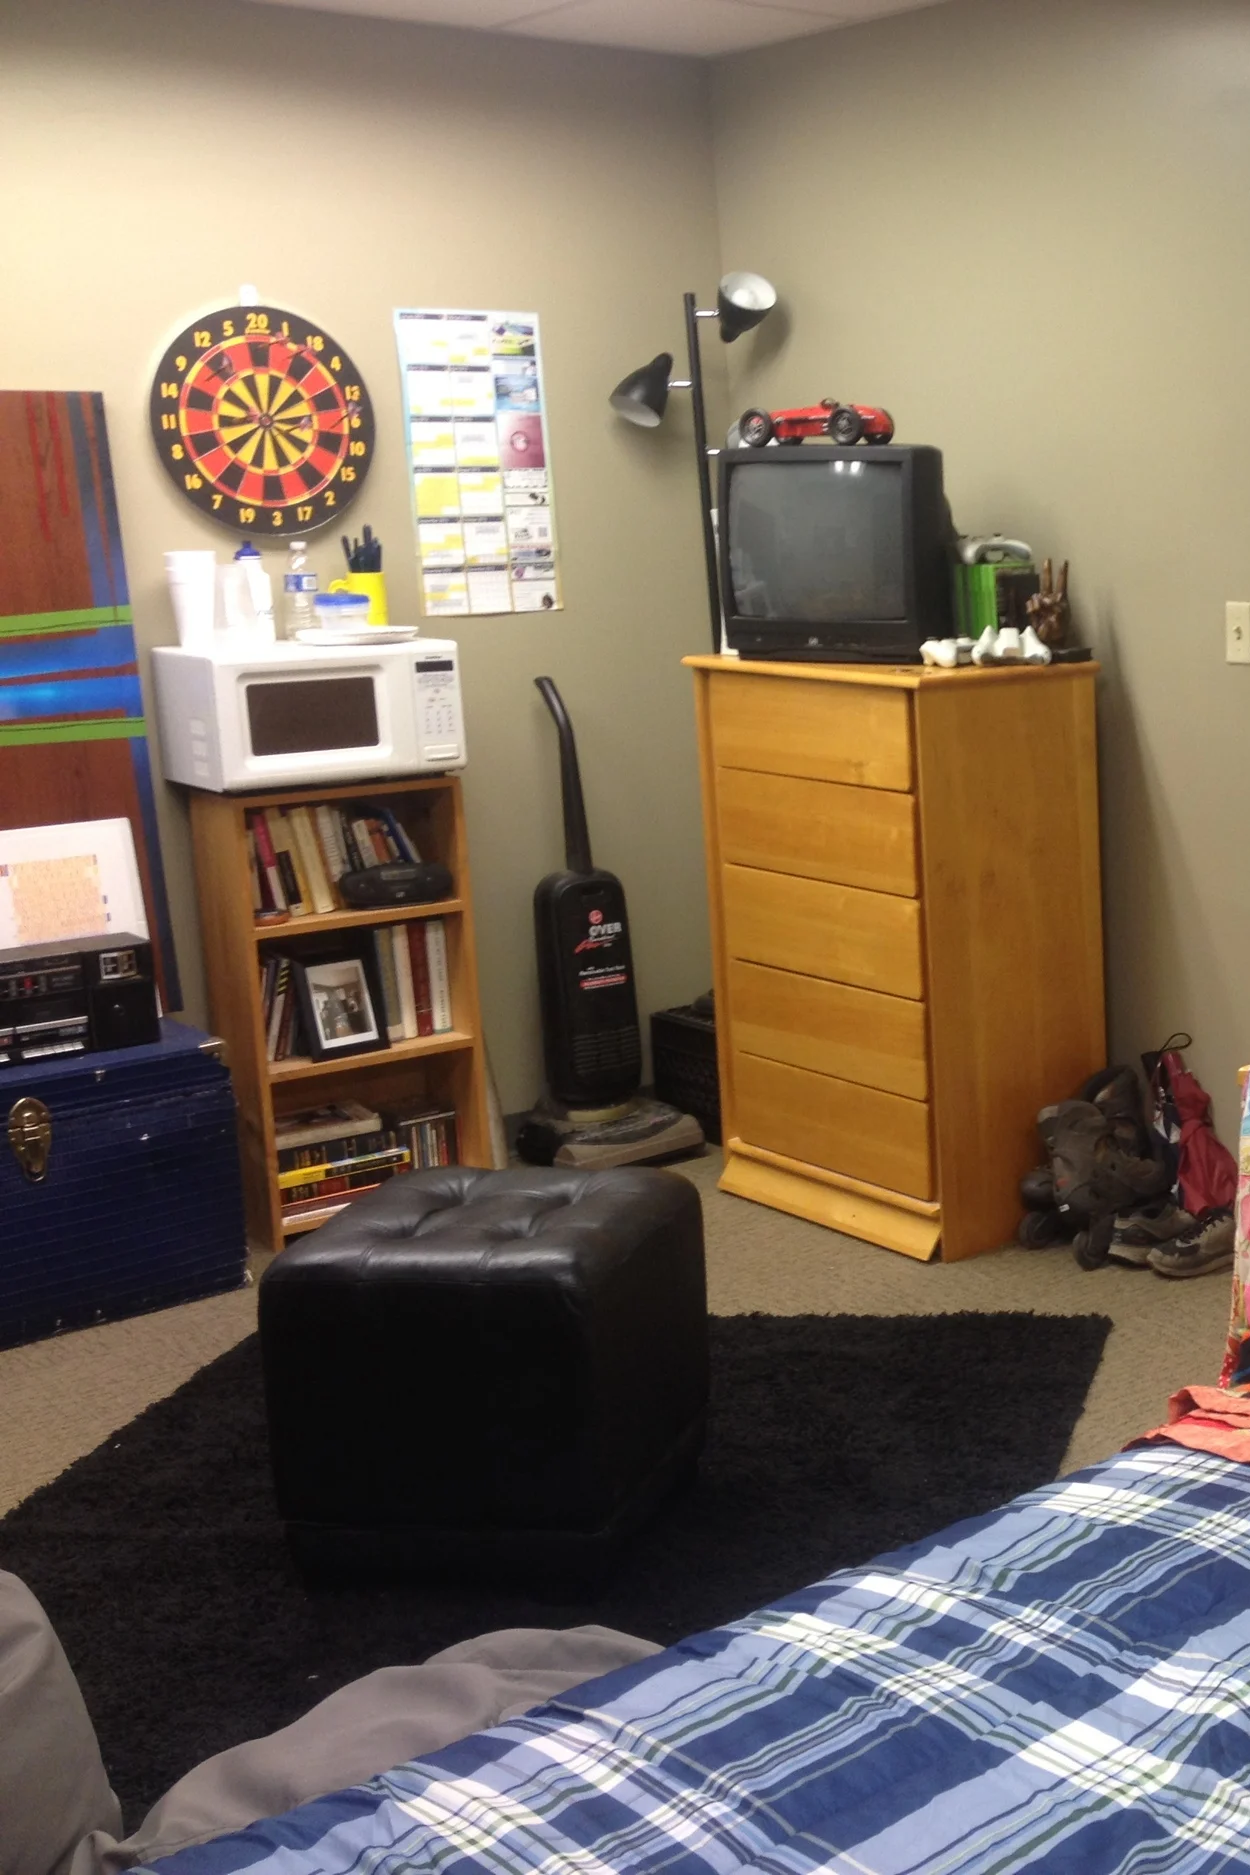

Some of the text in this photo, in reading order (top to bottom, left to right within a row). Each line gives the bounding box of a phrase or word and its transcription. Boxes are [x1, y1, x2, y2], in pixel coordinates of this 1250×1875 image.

[223, 319, 235, 336] 5
[245, 313, 269, 329] 20
[281, 322, 290, 337] 1
[193, 331, 212, 348] 12
[306, 335, 325, 351] 18
[174, 355, 187, 371] 9
[330, 356, 342, 372] 4
[161, 383, 179, 399] 14
[161, 414, 177, 430] 11
[171, 444, 185, 460] 8
[349, 441, 366, 457] 10
[184, 474, 203, 490] 16
[340, 467, 356, 482] 15
[212, 495, 223, 509] 7
[324, 491, 336, 506] 2
[239, 507, 256, 523] 19
[272, 511, 284, 527] 3
[297, 506, 313, 521] 17
